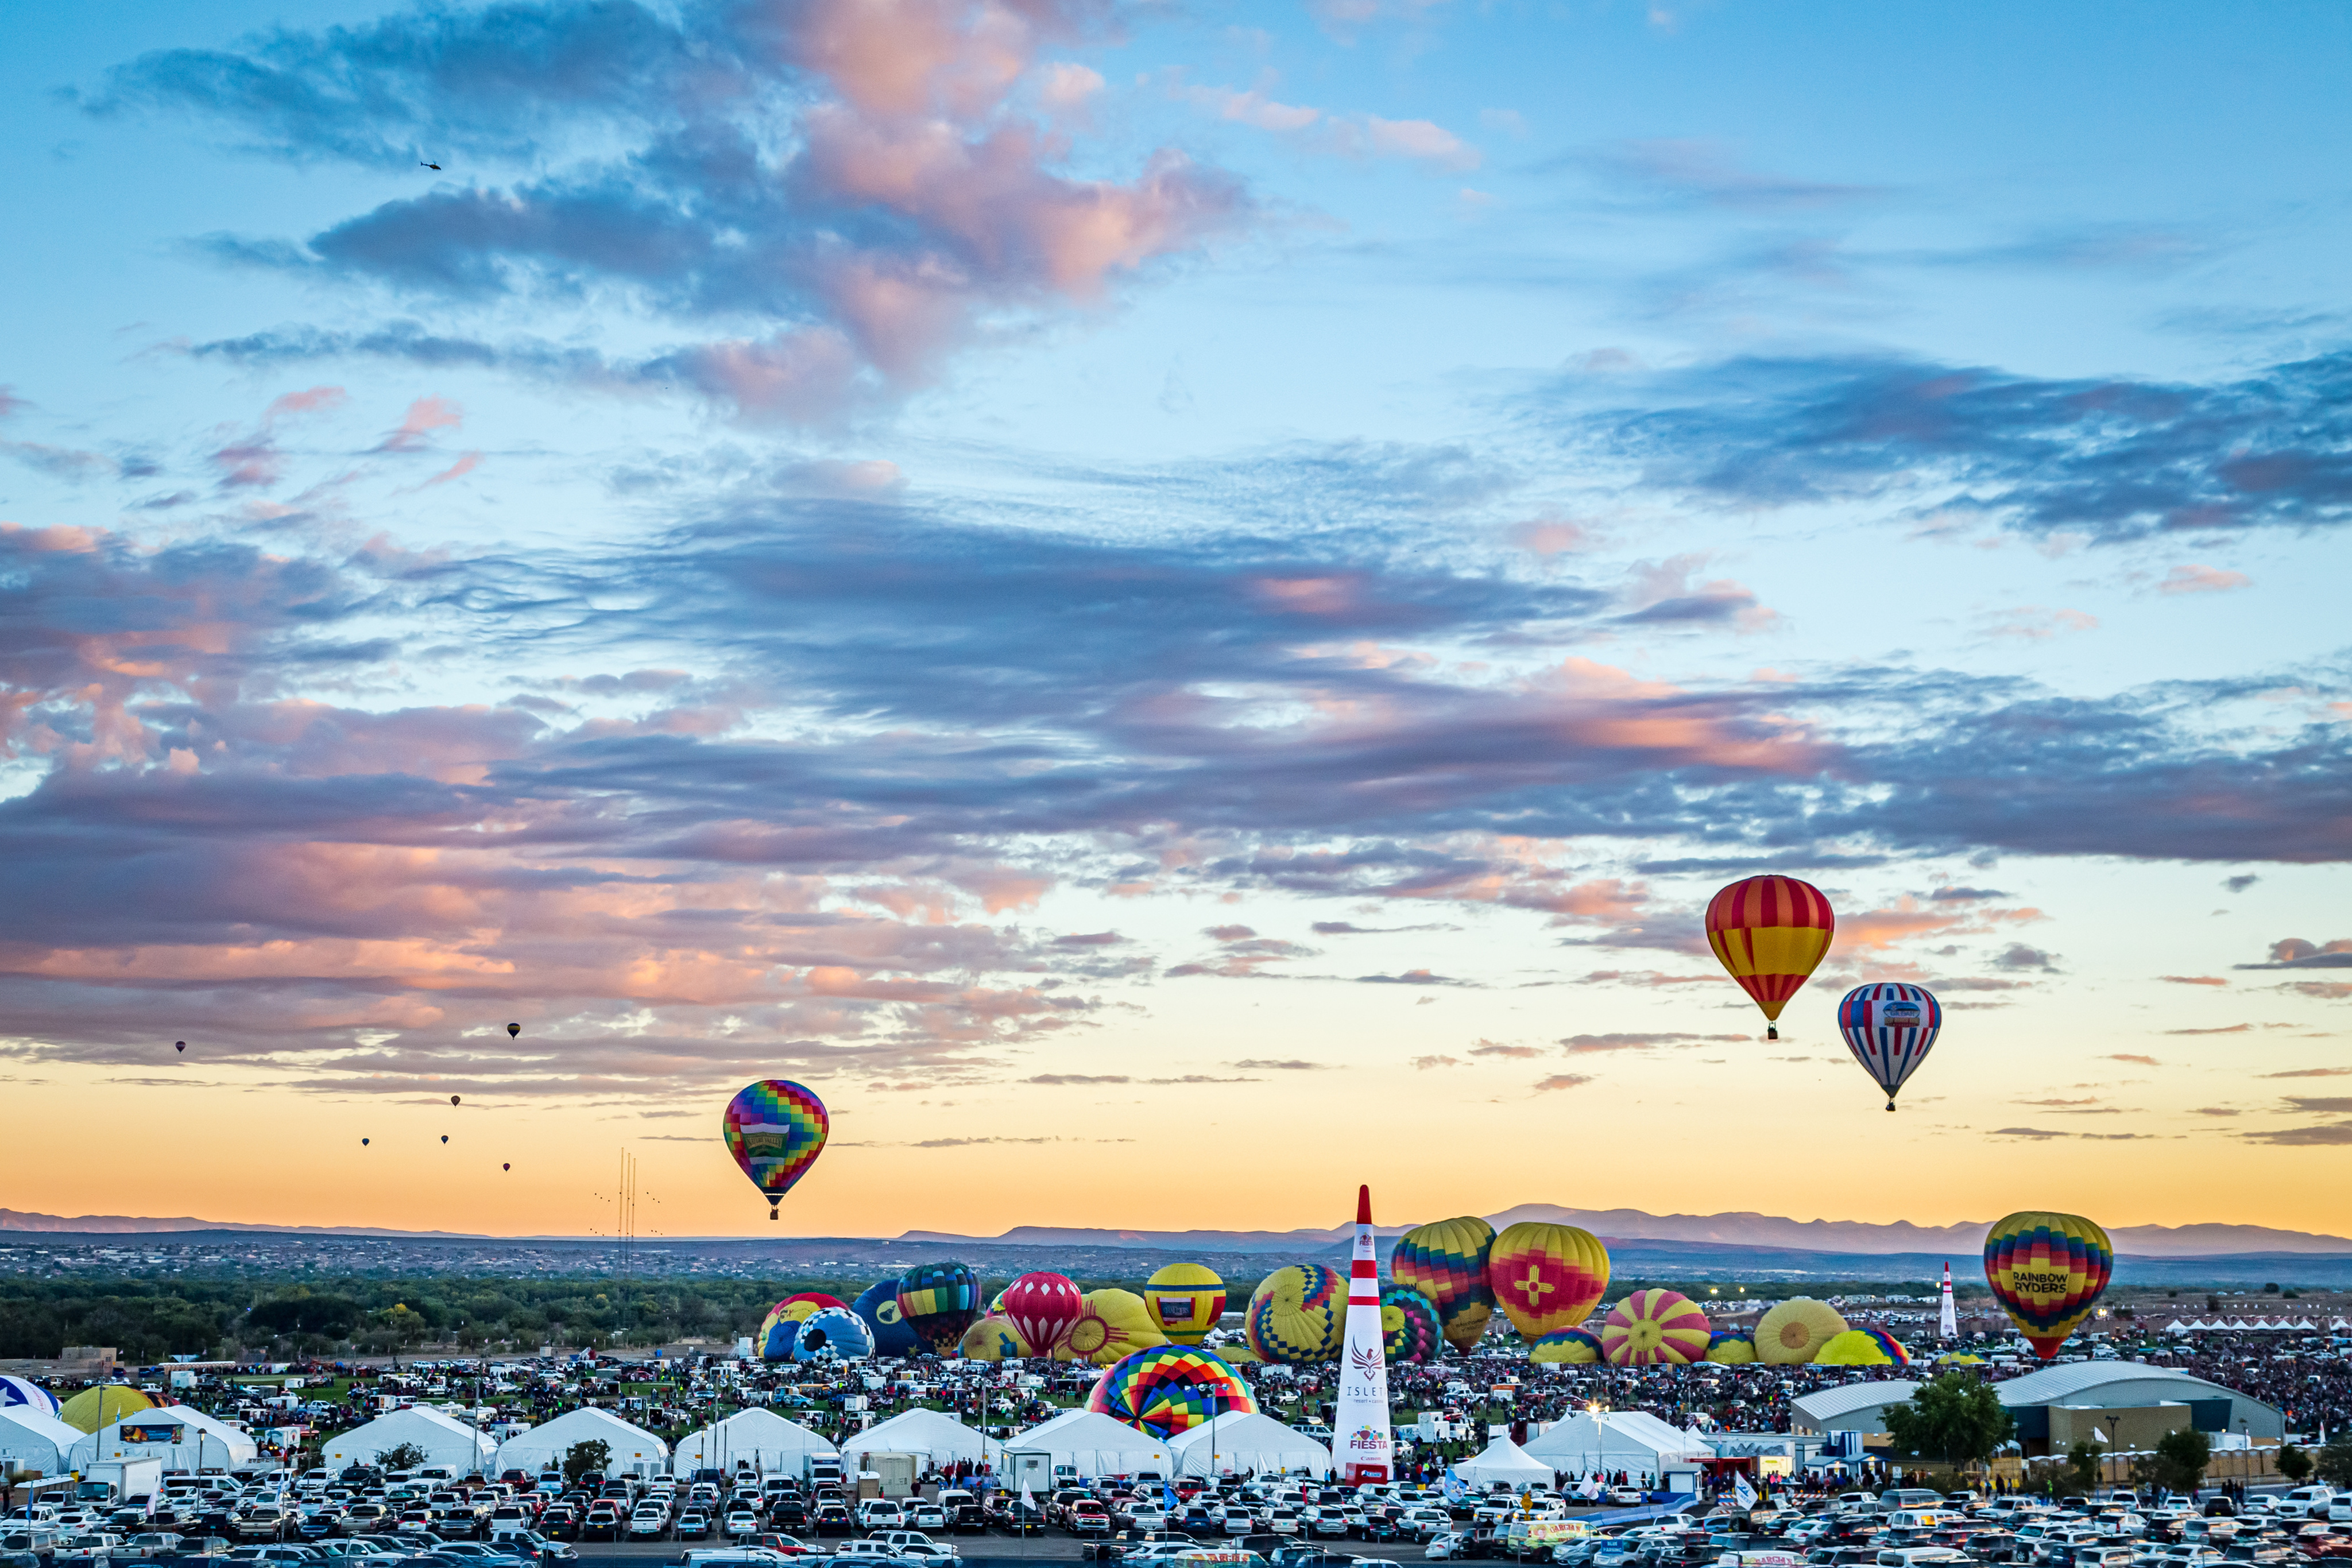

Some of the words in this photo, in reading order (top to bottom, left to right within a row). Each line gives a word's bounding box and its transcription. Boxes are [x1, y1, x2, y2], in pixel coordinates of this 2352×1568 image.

[2013, 1271, 2068, 1283] RAINBOW
[2015, 1281, 2067, 1294] RYDERS
[1350, 1440, 1388, 1449] FIESTA
